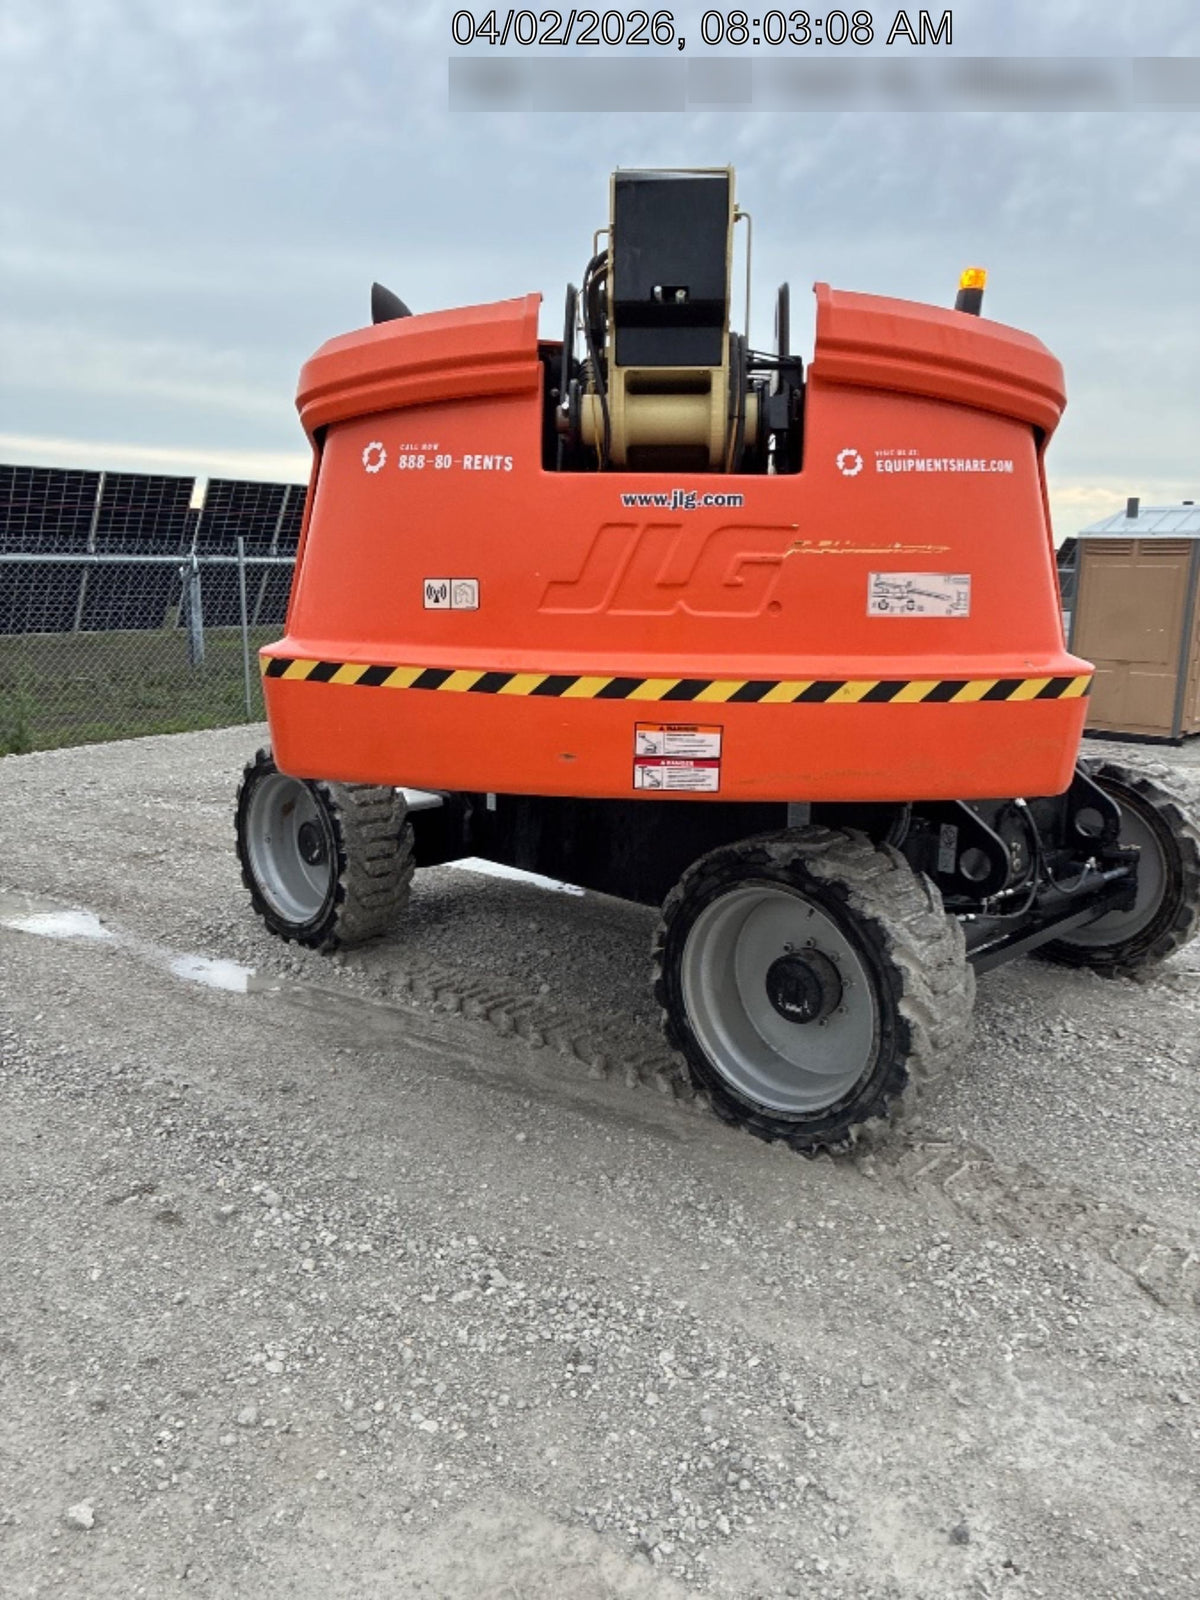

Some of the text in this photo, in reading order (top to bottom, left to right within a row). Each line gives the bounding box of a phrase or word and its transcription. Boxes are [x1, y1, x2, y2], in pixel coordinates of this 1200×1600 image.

[876, 459, 1014, 473] EQUIPMENTSHARE.COM
[620, 489, 744, 510] www.jlg.com
[537, 522, 799, 617] JLG
